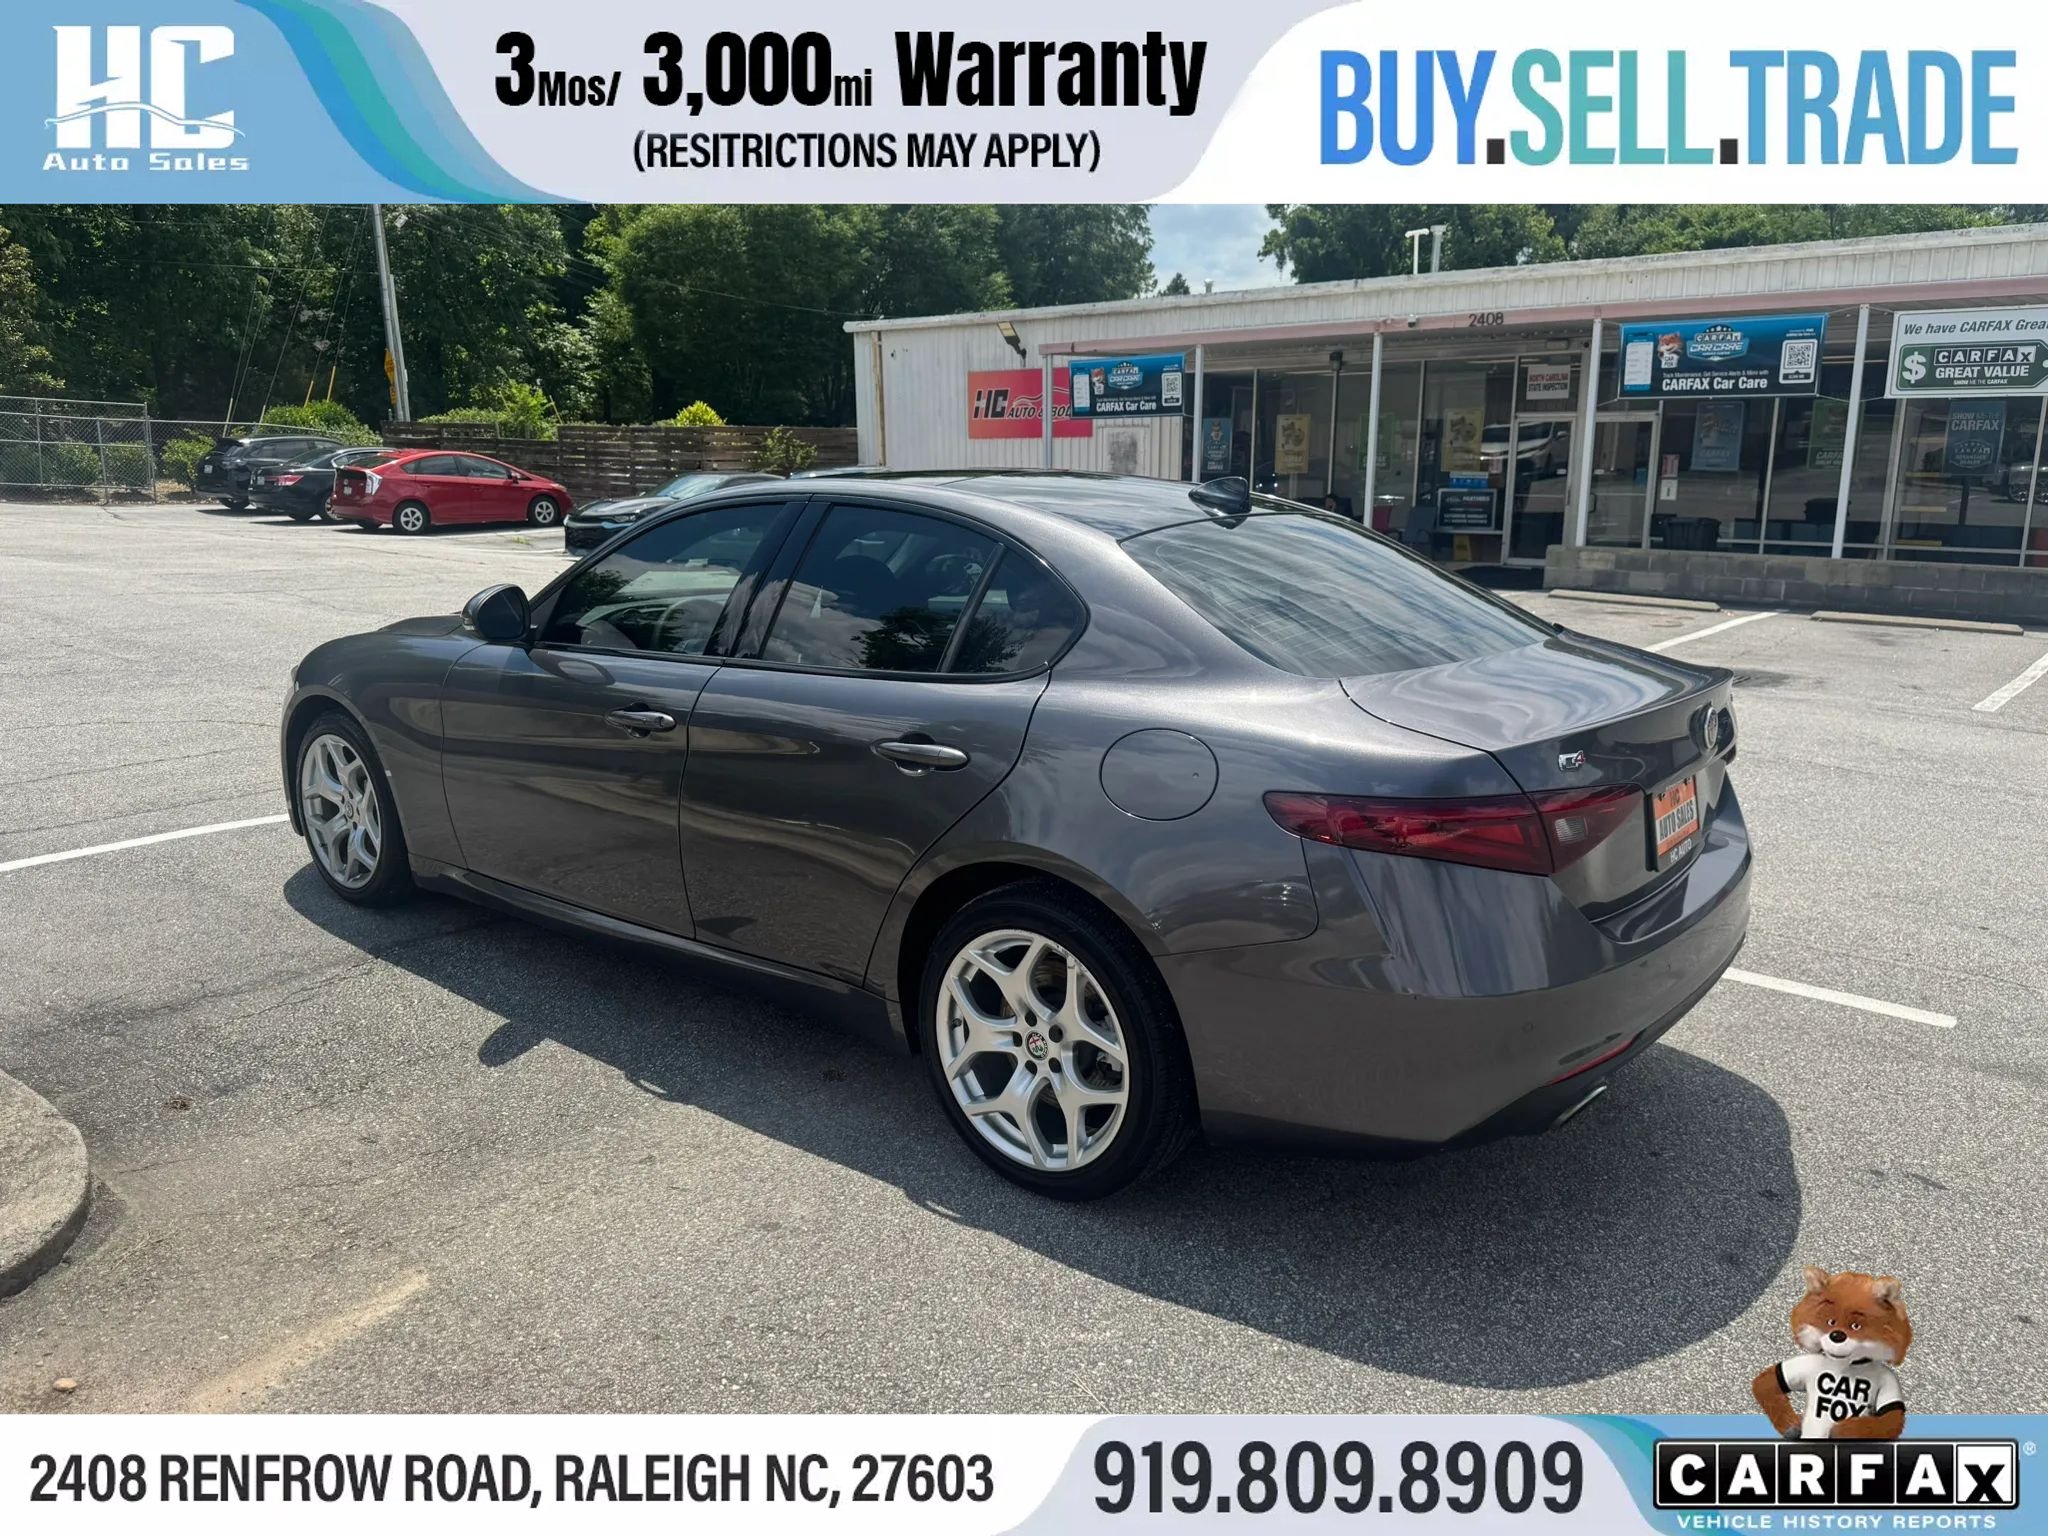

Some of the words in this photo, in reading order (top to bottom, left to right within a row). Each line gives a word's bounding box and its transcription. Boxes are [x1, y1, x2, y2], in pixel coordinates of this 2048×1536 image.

[1468, 312, 1504, 328] 2408
[1903, 324, 1922, 335] We
[1925, 323, 1957, 334] have
[1959, 320, 2014, 333] CARFAX
[1936, 347, 2036, 364] CARFAX
[1935, 367, 1981, 379] GREAT
[1984, 365, 2030, 378] VALUE
[1662, 377, 1710, 391] CARFAX
[1713, 377, 1736, 390] Car
[1738, 376, 1768, 389] Care
[1008, 406, 1036, 418] AUTO
[1096, 401, 1124, 412] CARFAX
[1125, 401, 1139, 411] Car
[1140, 400, 1157, 410] Care
[1951, 419, 2000, 431] CARFAX
[1815, 451, 1845, 459] CARFA
[1659, 812, 1676, 840] AUTO
[1676, 799, 1694, 830] SALES
